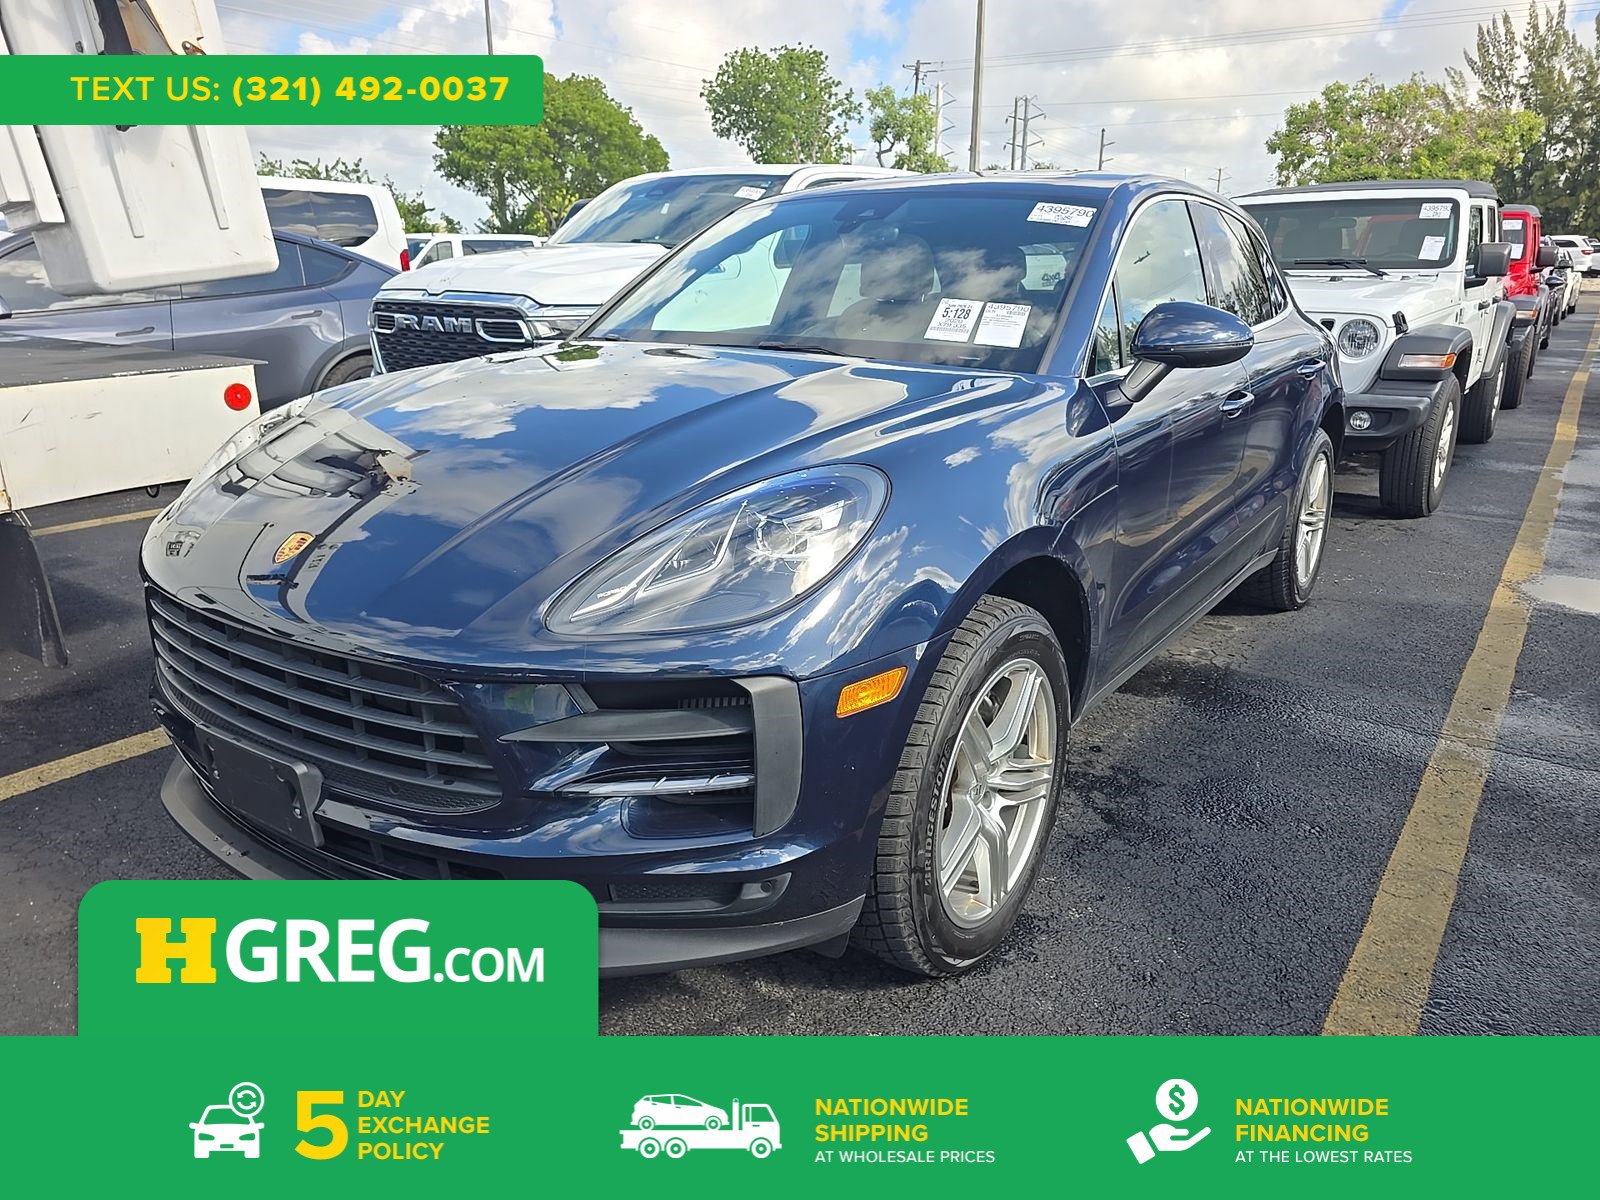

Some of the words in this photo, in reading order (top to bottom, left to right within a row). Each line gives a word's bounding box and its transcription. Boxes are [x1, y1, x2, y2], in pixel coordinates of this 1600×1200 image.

[1037, 205, 1095, 217] 4395790
[942, 307, 971, 320] 5:128
[396, 314, 473, 333] RAM
[924, 742, 951, 887] BRIDGESTONE
